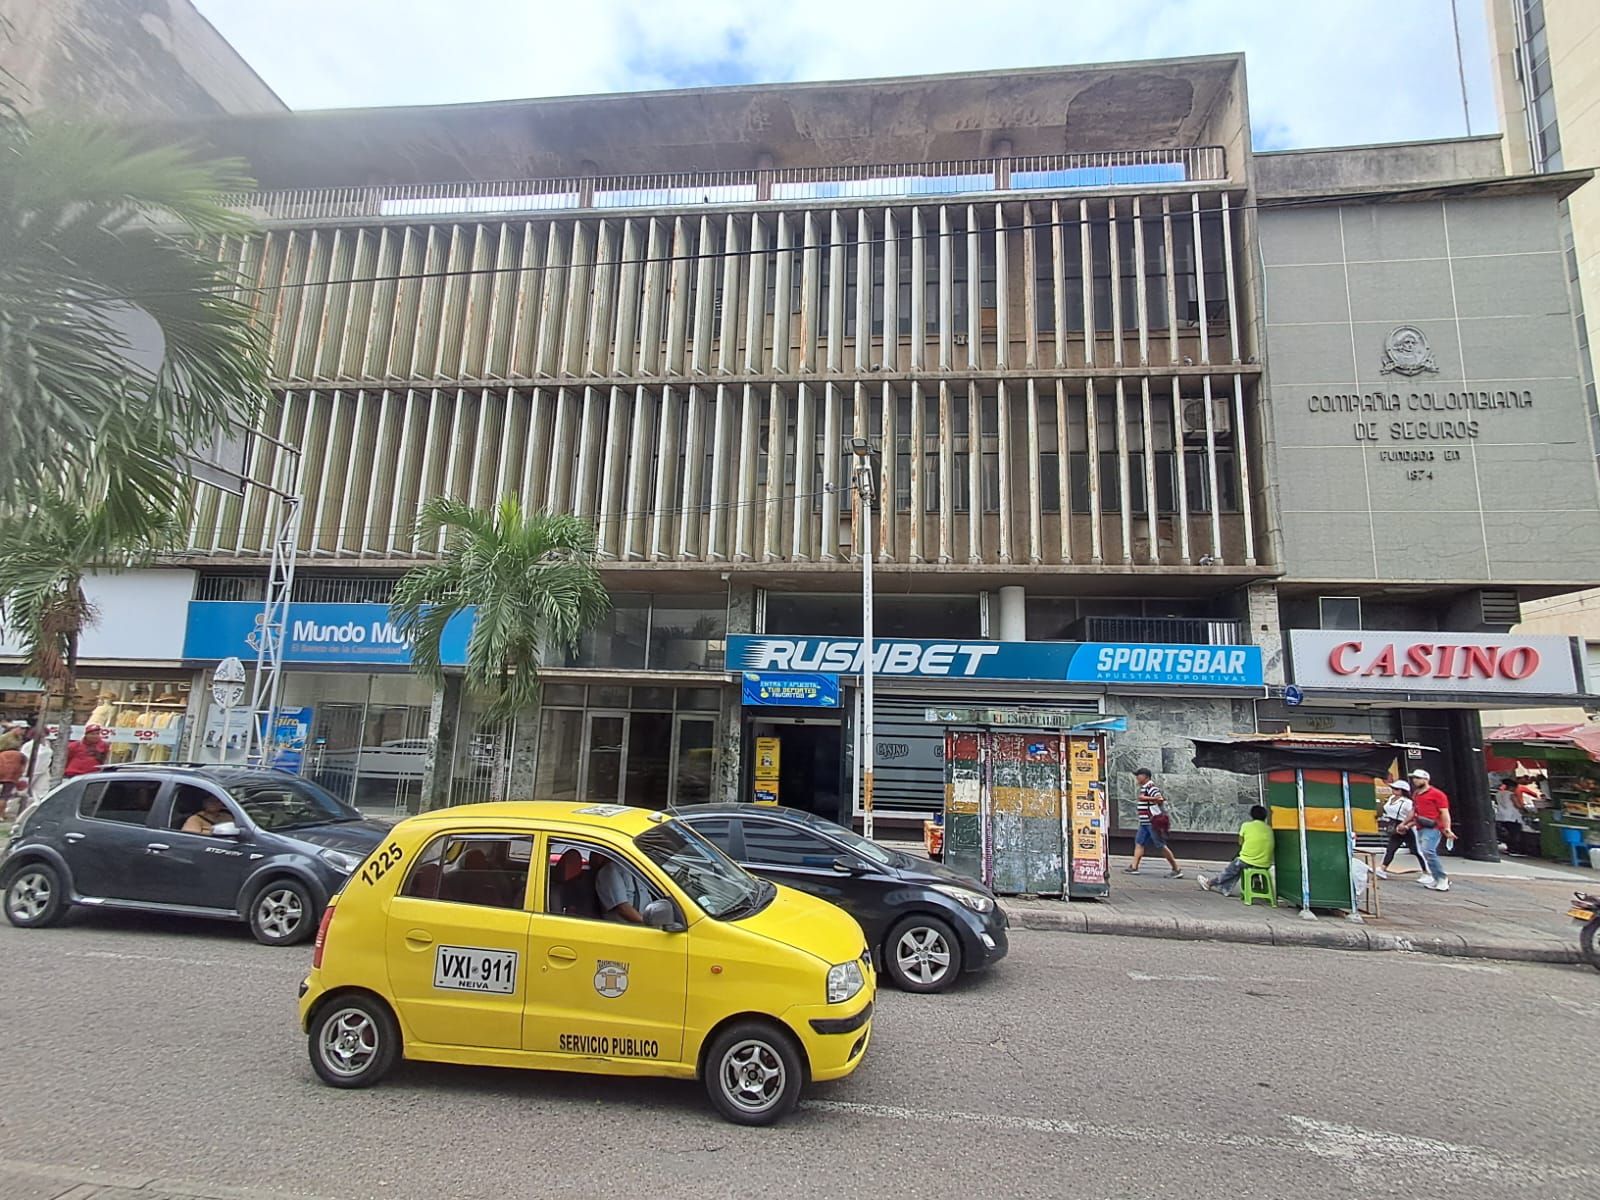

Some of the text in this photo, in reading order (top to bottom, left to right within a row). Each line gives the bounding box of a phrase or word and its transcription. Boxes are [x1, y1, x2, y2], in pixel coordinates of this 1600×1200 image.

[1308, 390, 1533, 413] COMPAÑIA COLOMBIANA
[1353, 421, 1479, 441] DE SEGUROS
[292, 620, 366, 642] Mundo
[740, 640, 999, 676] RUSHBET
[1097, 648, 1247, 674] SPORTSBAR
[1328, 641, 1541, 680] CASINO
[1096, 673, 1247, 683] APUESTAS DEPORTIVAS
[134, 730, 159, 738] 50%
[876, 743, 909, 758] CASINO
[1077, 802, 1095, 811] 5GB
[361, 841, 403, 886] 1225
[458, 980, 489, 990] NEIVA
[559, 1034, 659, 1058] SERVICIO PUBLICO
